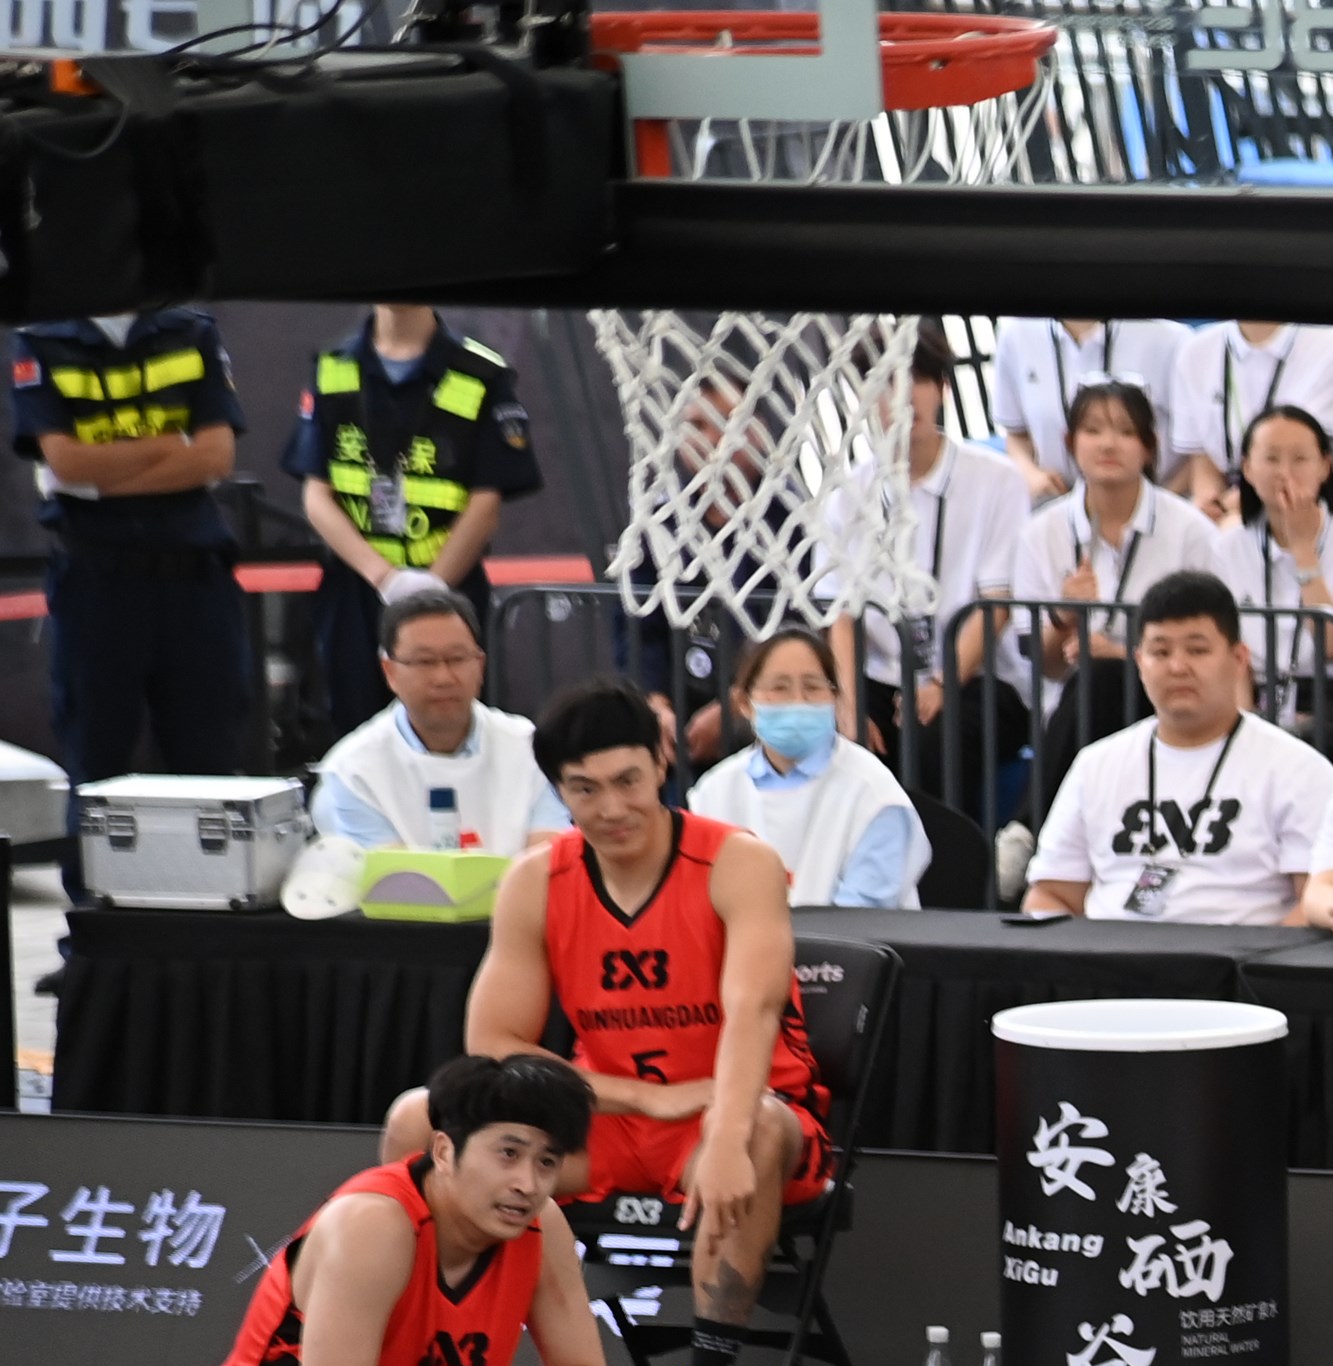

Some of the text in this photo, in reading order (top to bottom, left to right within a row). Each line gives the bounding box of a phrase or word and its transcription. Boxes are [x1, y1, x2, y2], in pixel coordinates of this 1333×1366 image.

[793, 960, 845, 983] orts
[1002, 1219, 1104, 1259] Ankang
[1003, 1254, 1060, 1287] XiGu
[1179, 1299, 1279, 1330] 饮用天然矿泉水
